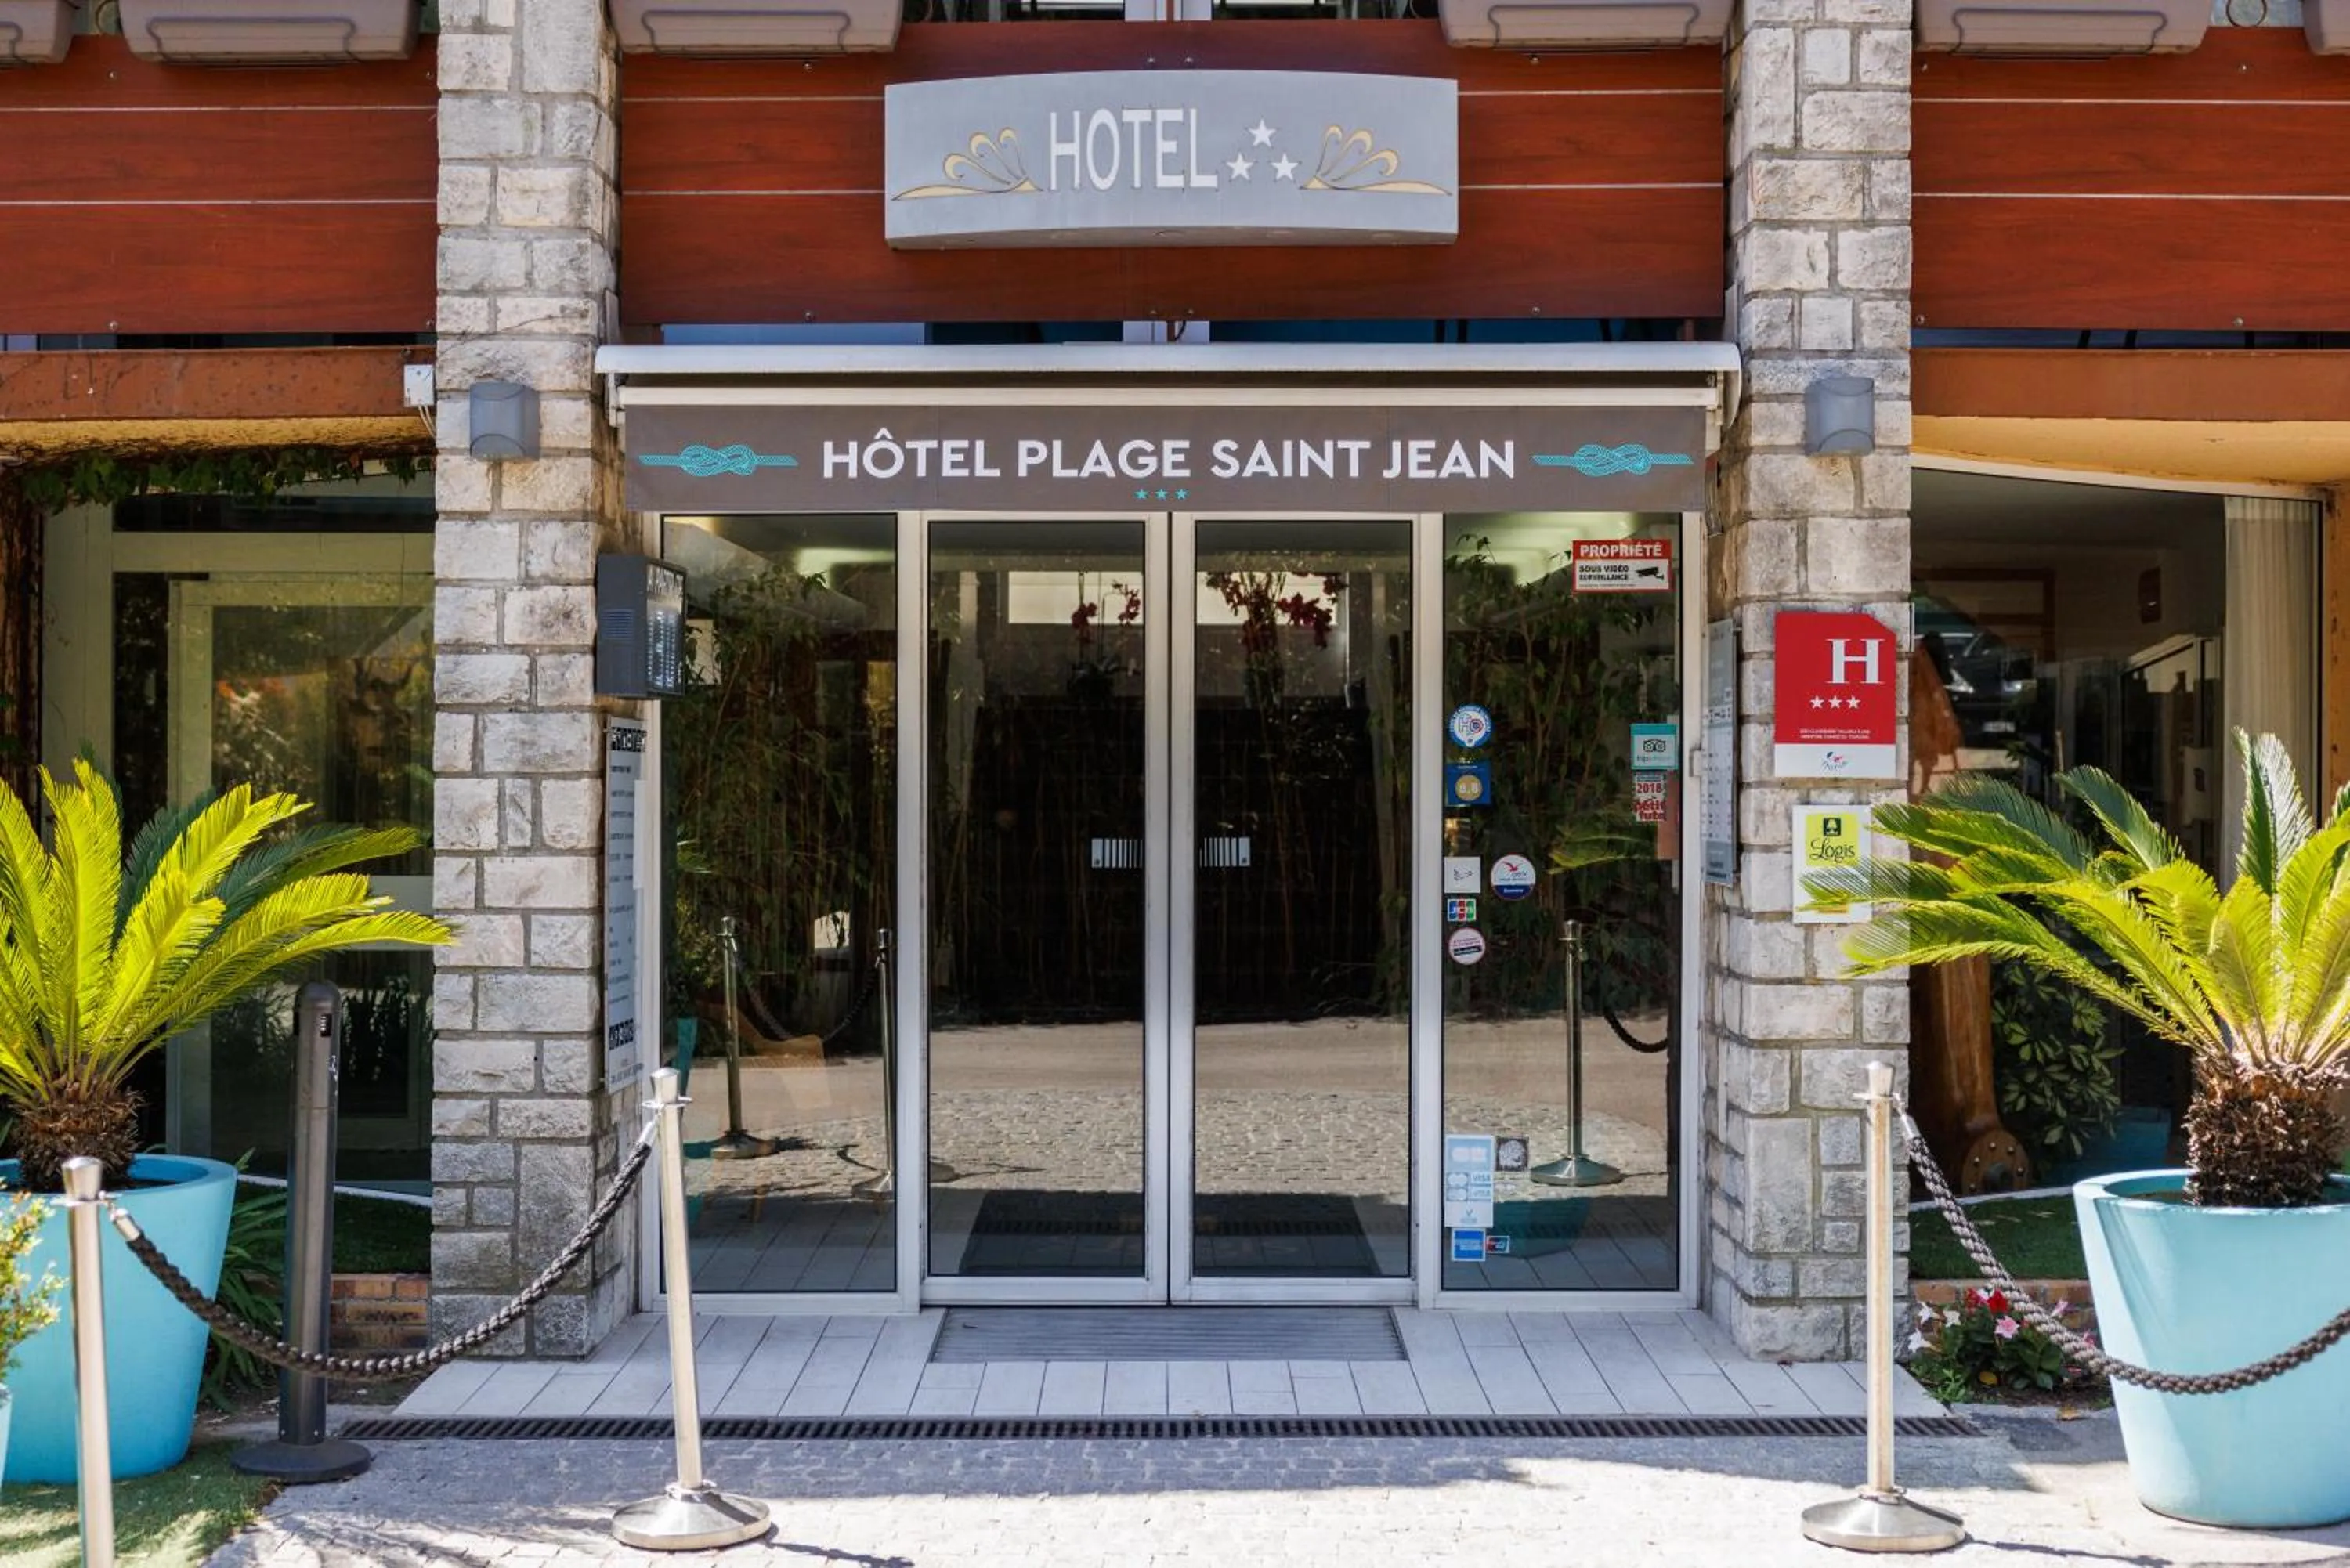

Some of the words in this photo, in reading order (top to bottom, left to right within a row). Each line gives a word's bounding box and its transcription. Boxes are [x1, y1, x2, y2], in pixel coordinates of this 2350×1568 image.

[1050, 107, 1218, 191] HOTEL
[822, 427, 1000, 478] HÔTEL
[1018, 439, 1191, 478] PLAGE
[1209, 439, 1370, 478] SAINT
[1383, 439, 1514, 478] JEAN
[1579, 541, 1663, 557] PROPRIÉTÉ
[1825, 638, 1885, 685] H
[1810, 836, 1856, 864] Logis
